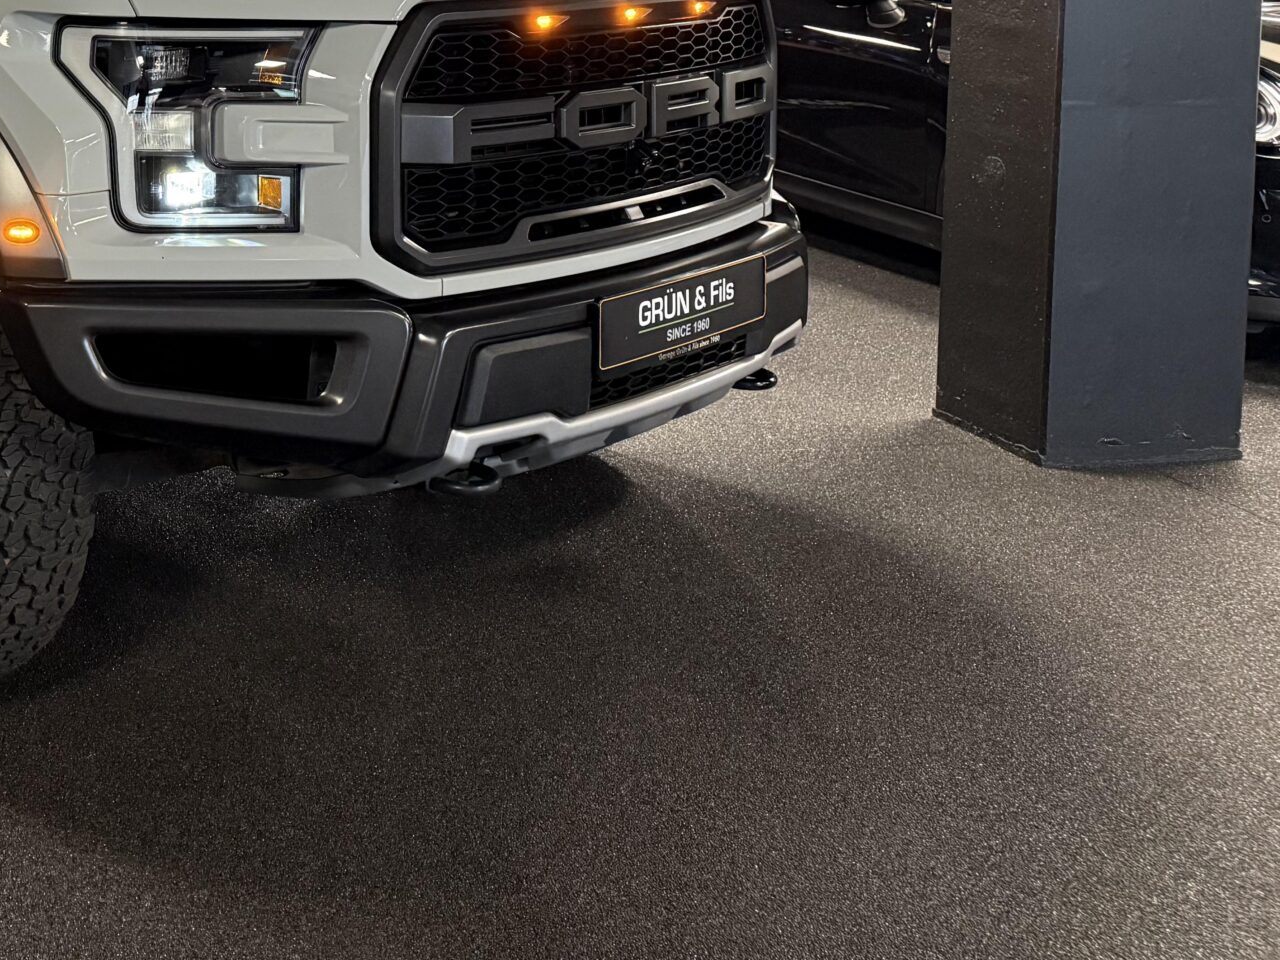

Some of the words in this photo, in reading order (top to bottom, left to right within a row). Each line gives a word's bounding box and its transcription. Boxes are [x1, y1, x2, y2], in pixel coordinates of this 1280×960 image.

[404, 64, 775, 164] FORD
[638, 288, 690, 327] GRÜN
[694, 285, 707, 311] &
[710, 277, 735, 306] Fils
[666, 324, 692, 342] SINCE
[693, 317, 710, 333] 1960
